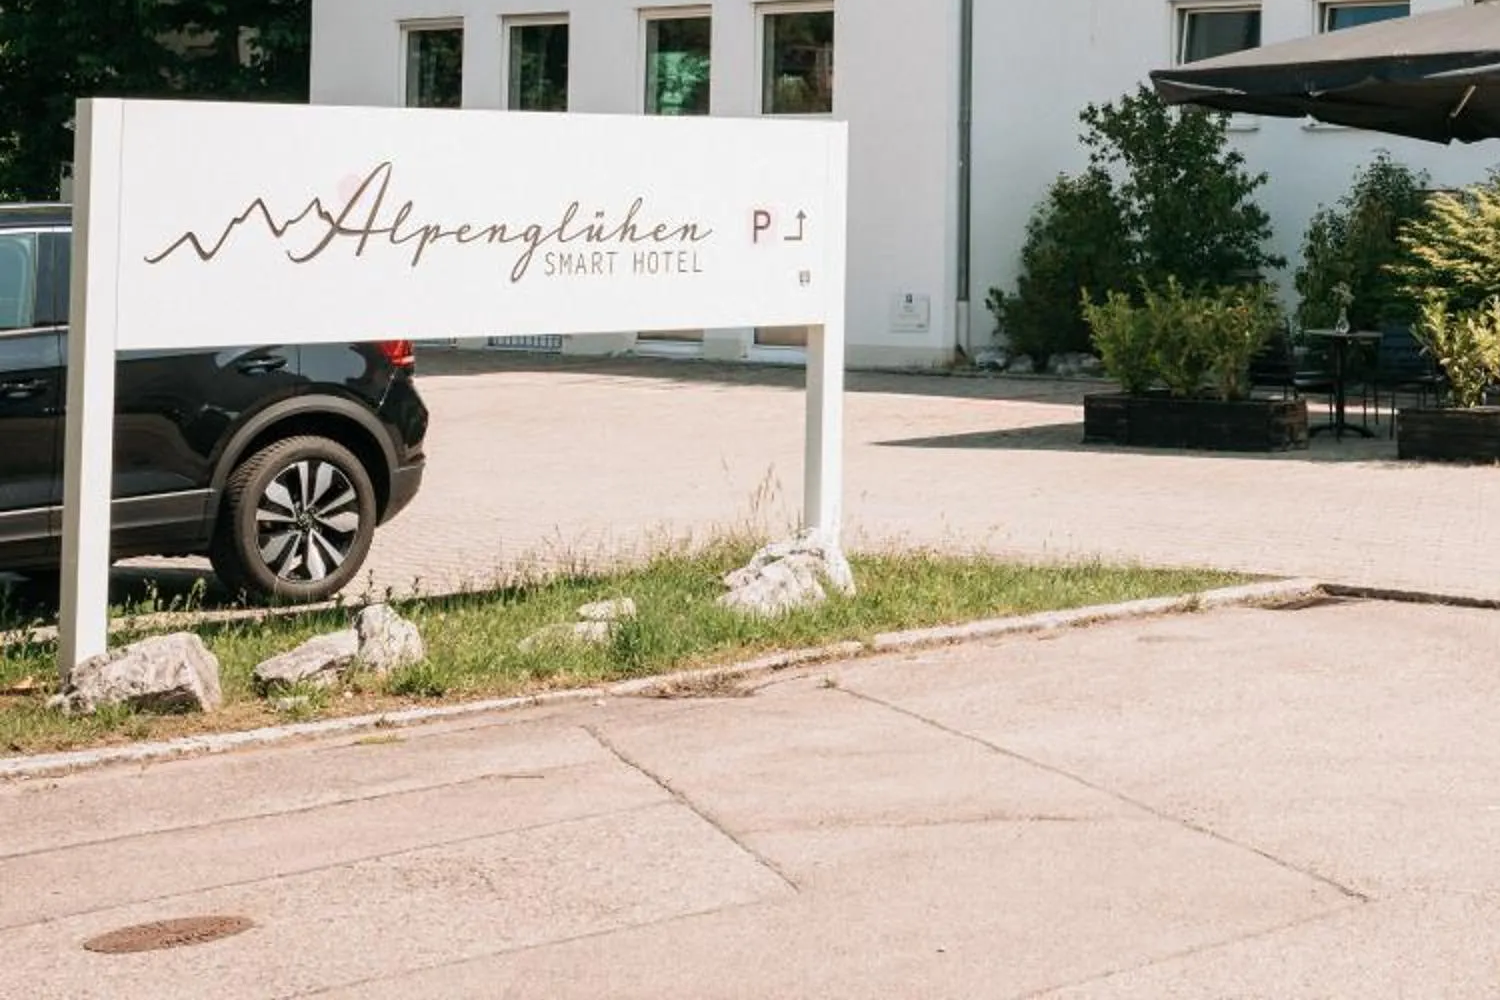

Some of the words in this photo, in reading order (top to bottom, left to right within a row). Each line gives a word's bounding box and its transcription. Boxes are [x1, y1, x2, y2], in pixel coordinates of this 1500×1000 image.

[287, 161, 714, 282] Alpenglühen
[753, 209, 771, 244] P
[544, 250, 619, 276] SMART
[633, 250, 704, 275] HOTEL
